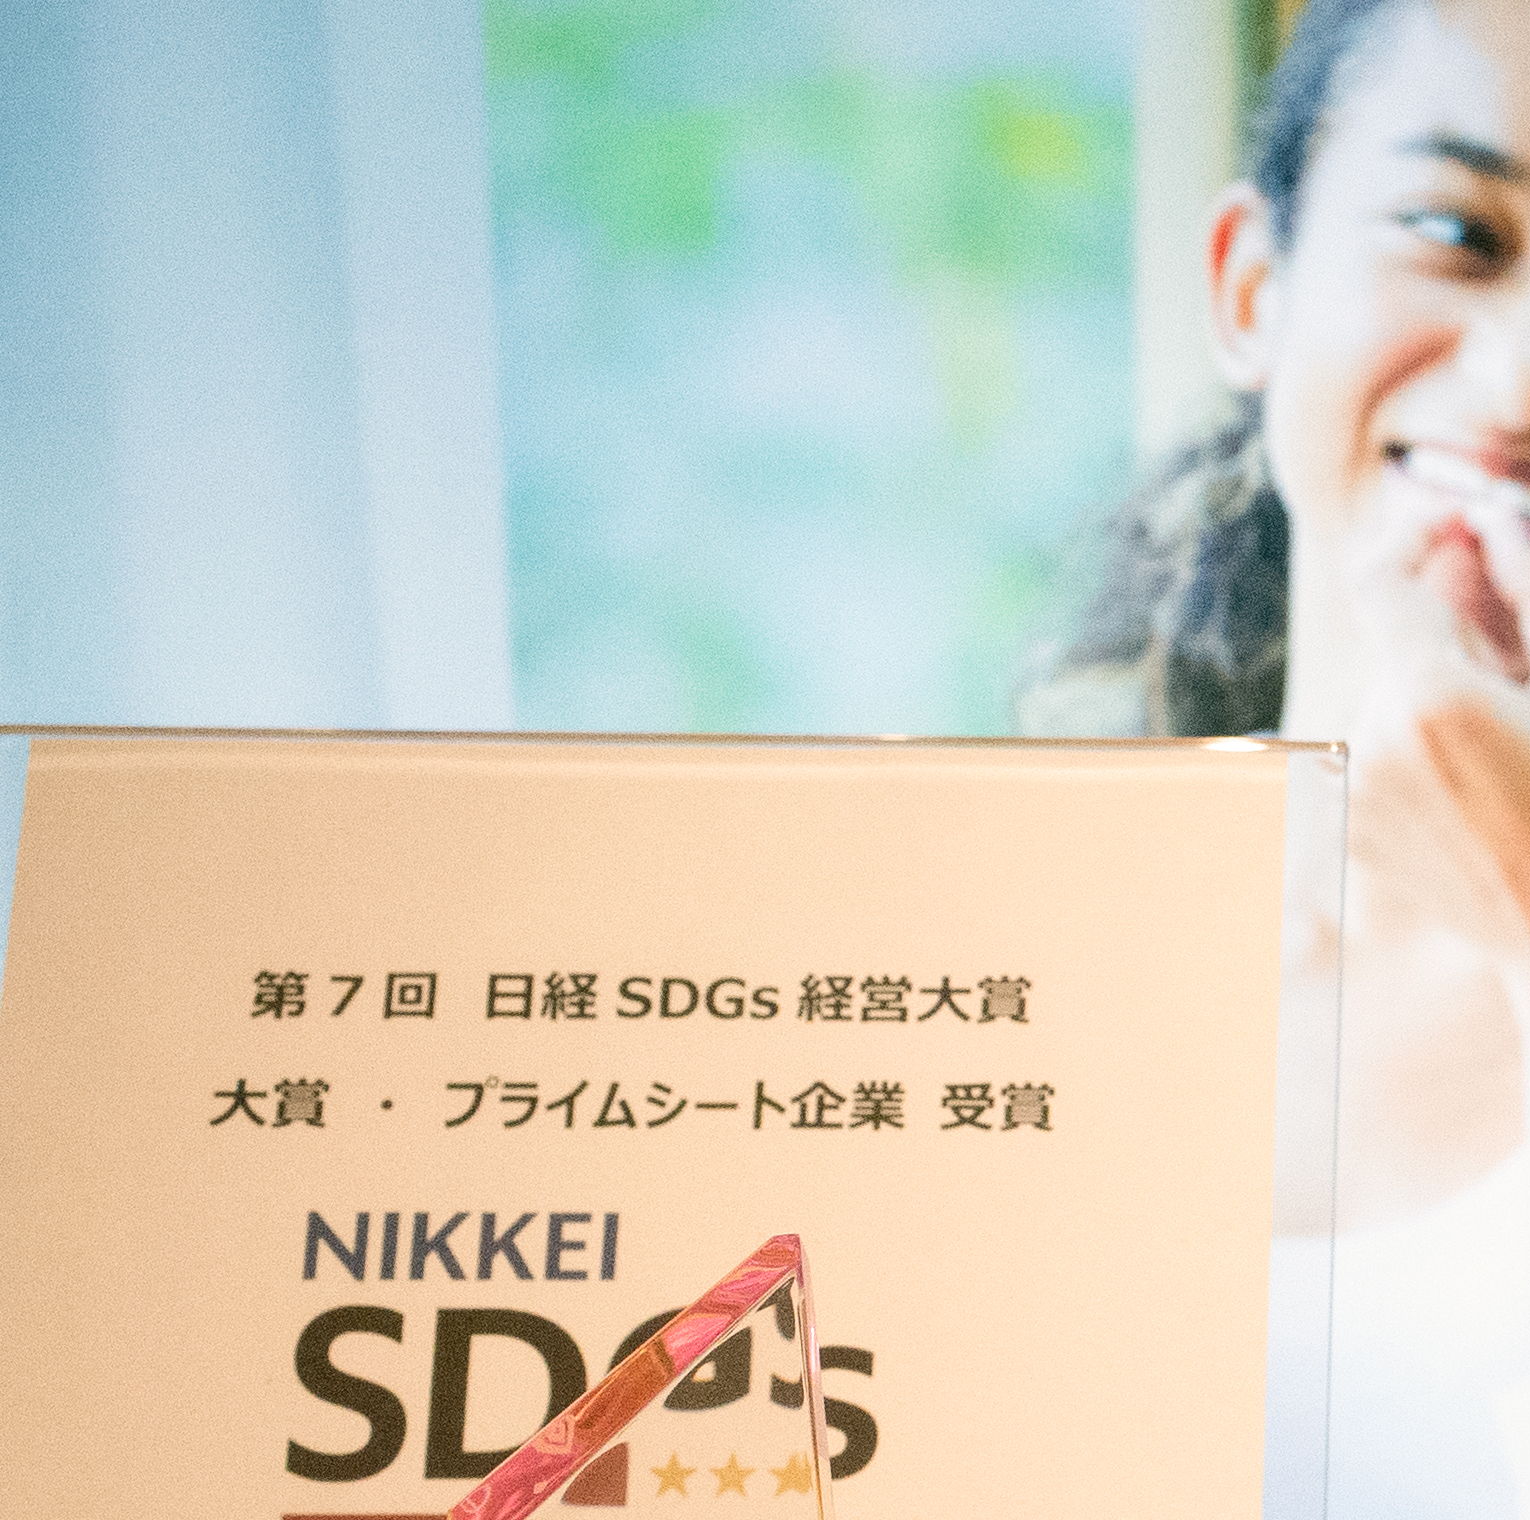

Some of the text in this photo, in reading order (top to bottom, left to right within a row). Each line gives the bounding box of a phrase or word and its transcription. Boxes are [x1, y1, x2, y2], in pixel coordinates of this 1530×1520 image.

[210, 1079, 330, 1129] 大賞
[443, 1075, 907, 1131] プライムシート企業
[940, 1081, 1055, 1132] 受賞
[302, 1210, 621, 1282] NIKKEI
